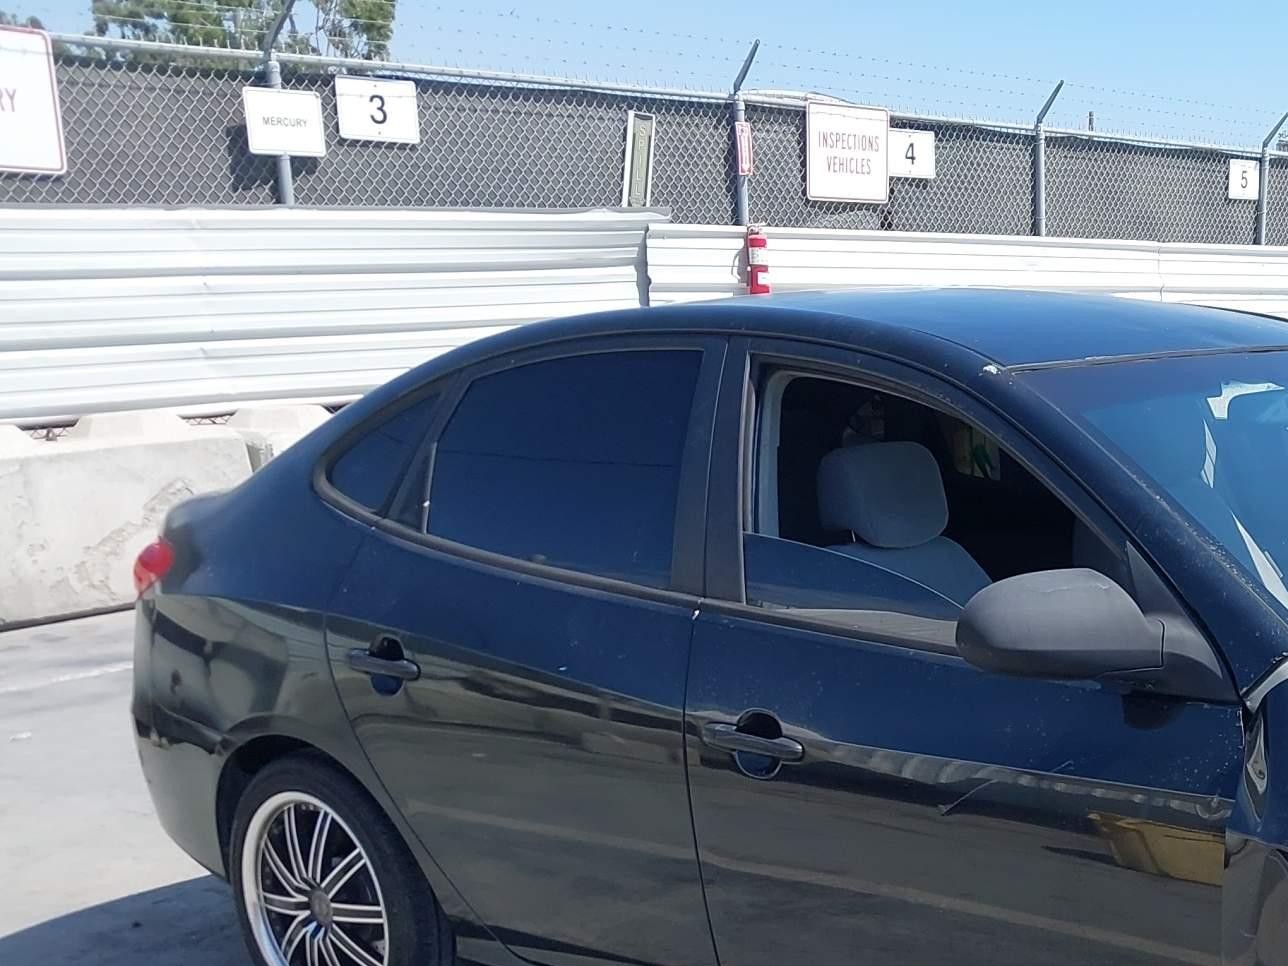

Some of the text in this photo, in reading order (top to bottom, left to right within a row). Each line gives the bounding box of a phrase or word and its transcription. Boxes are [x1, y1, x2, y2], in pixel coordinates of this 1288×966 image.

[368, 94, 388, 125] 3
[261, 115, 308, 128] MERCURY
[818, 130, 880, 153] INSPECTIONS
[904, 142, 916, 165] 4
[826, 155, 872, 175] VEHICLES
[1240, 170, 1248, 189] 5
